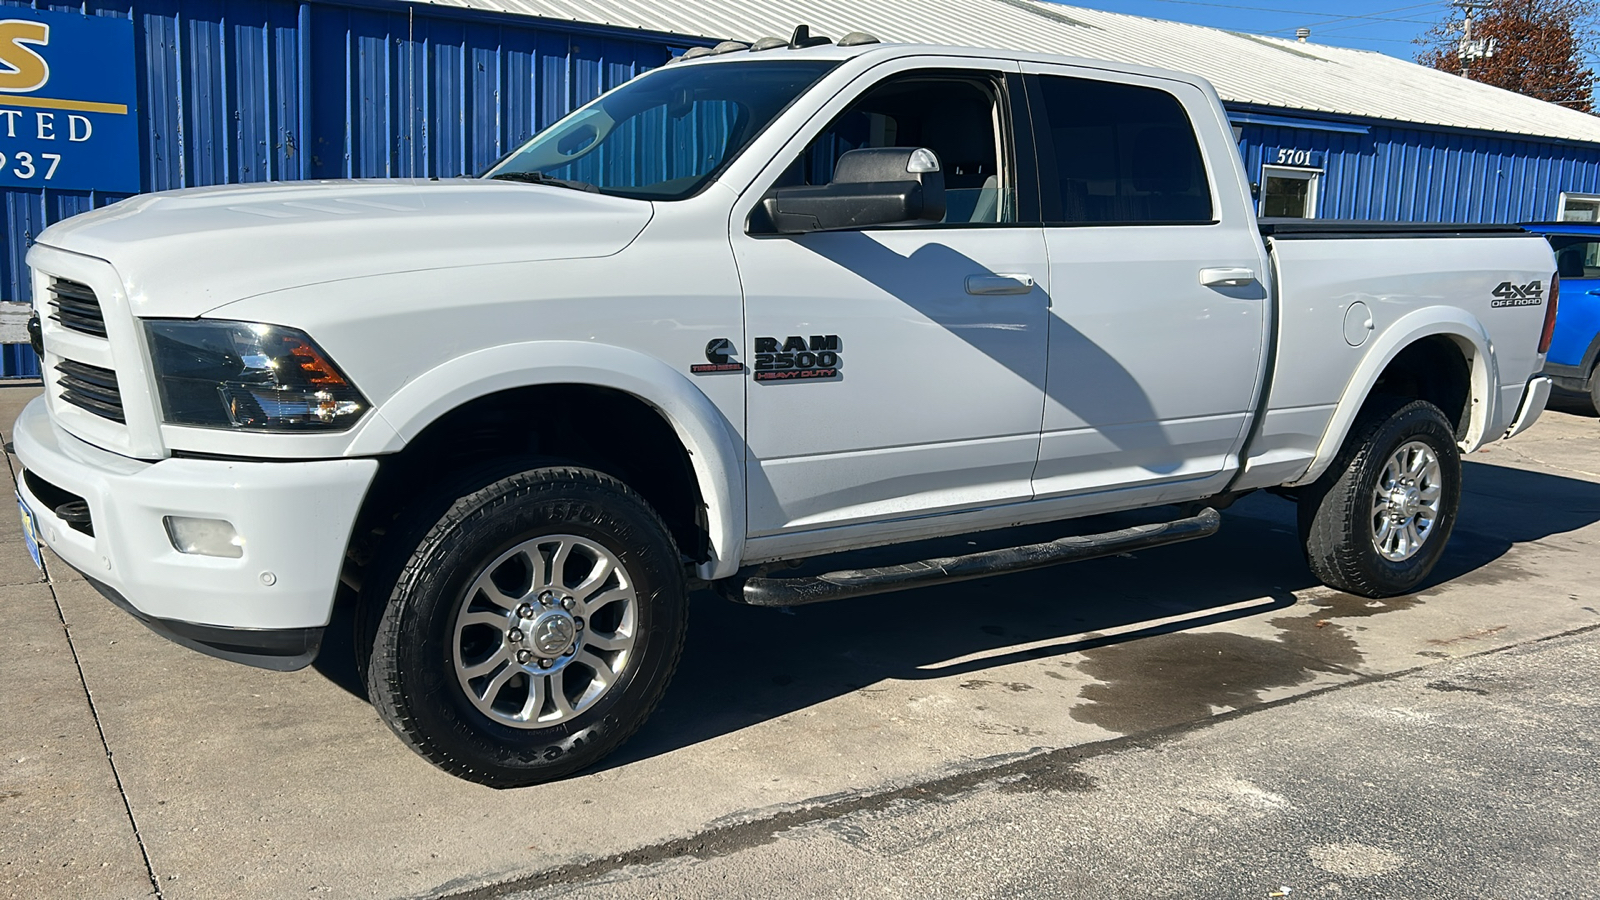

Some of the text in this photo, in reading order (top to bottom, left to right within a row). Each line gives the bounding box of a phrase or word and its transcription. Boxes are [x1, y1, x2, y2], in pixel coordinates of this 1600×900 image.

[1277, 149, 1311, 166] 5701
[1514, 298, 1541, 306] ROAD
[754, 334, 838, 353] RAM
[692, 363, 742, 372] TURBO DIESEL
[754, 351, 838, 370] 2500
[757, 368, 835, 380] HEAVY DUTY
